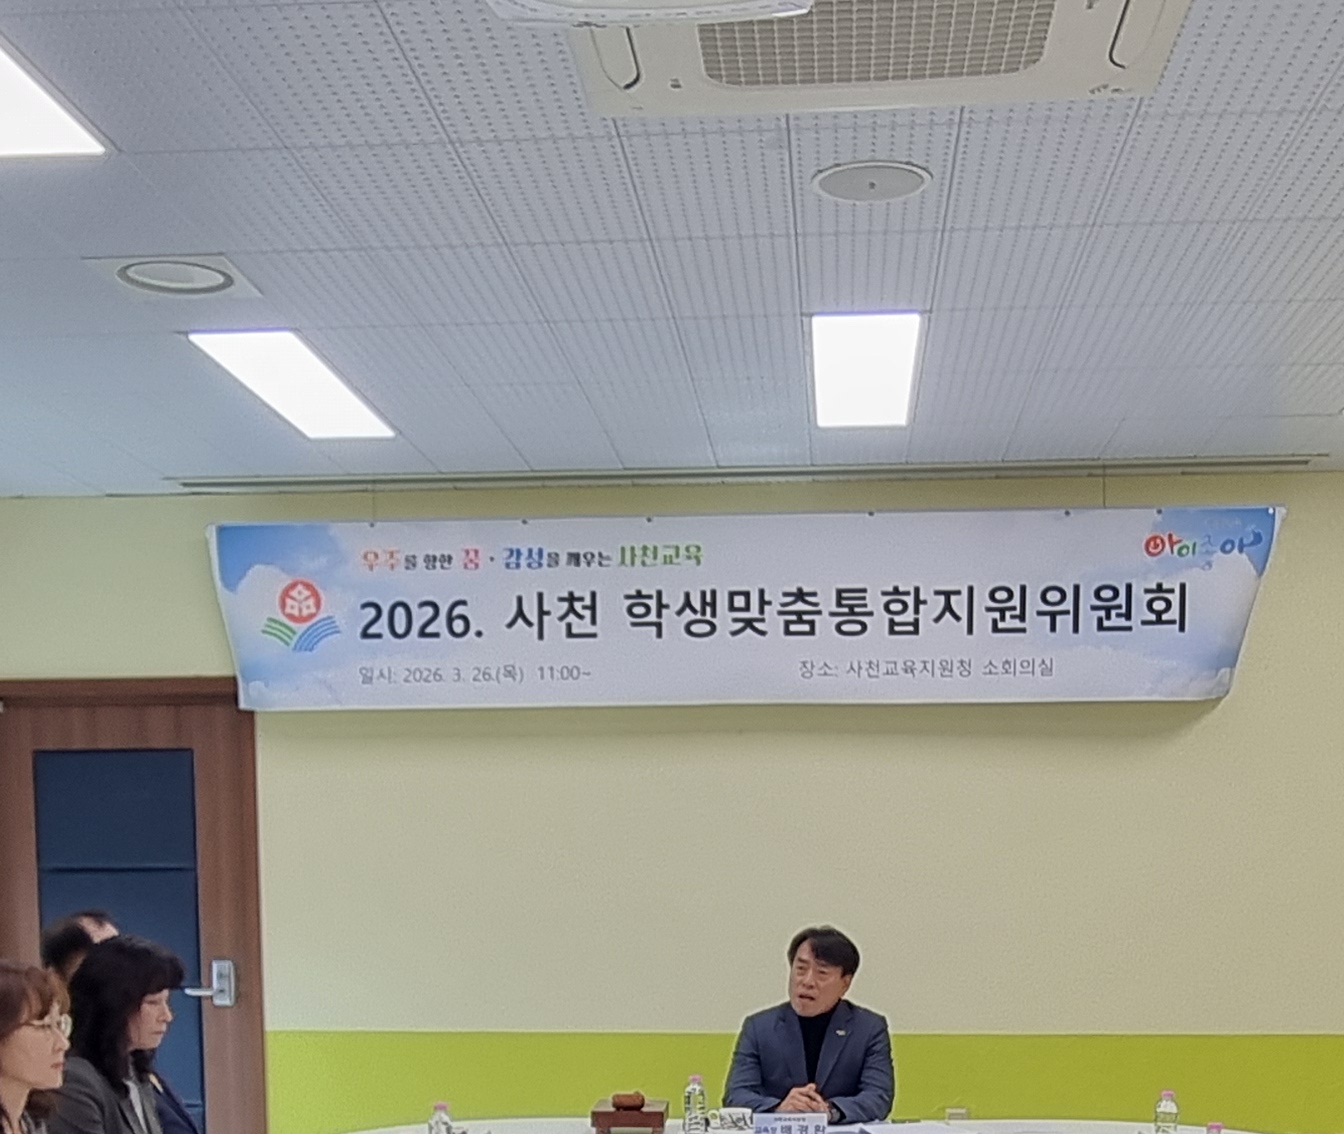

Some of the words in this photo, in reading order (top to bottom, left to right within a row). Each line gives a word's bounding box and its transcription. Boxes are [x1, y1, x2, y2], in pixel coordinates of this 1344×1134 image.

[362, 549, 417, 572] 우주를
[423, 553, 453, 571] 향한
[462, 548, 480, 570] 꿈
[504, 547, 560, 570] 감성을
[566, 551, 612, 568] 깨우는
[618, 544, 703, 568] 사천교육
[359, 599, 484, 640] 2026.
[504, 590, 599, 640] 사천
[623, 581, 1188, 639] 학생맞춤통합지원위원회
[358, 666, 397, 685] 일시:
[537, 665, 592, 682] 11:00~
[798, 658, 839, 679] 장소:
[845, 657, 973, 679] 사천교육지원청
[981, 656, 1055, 679] 소회의실
